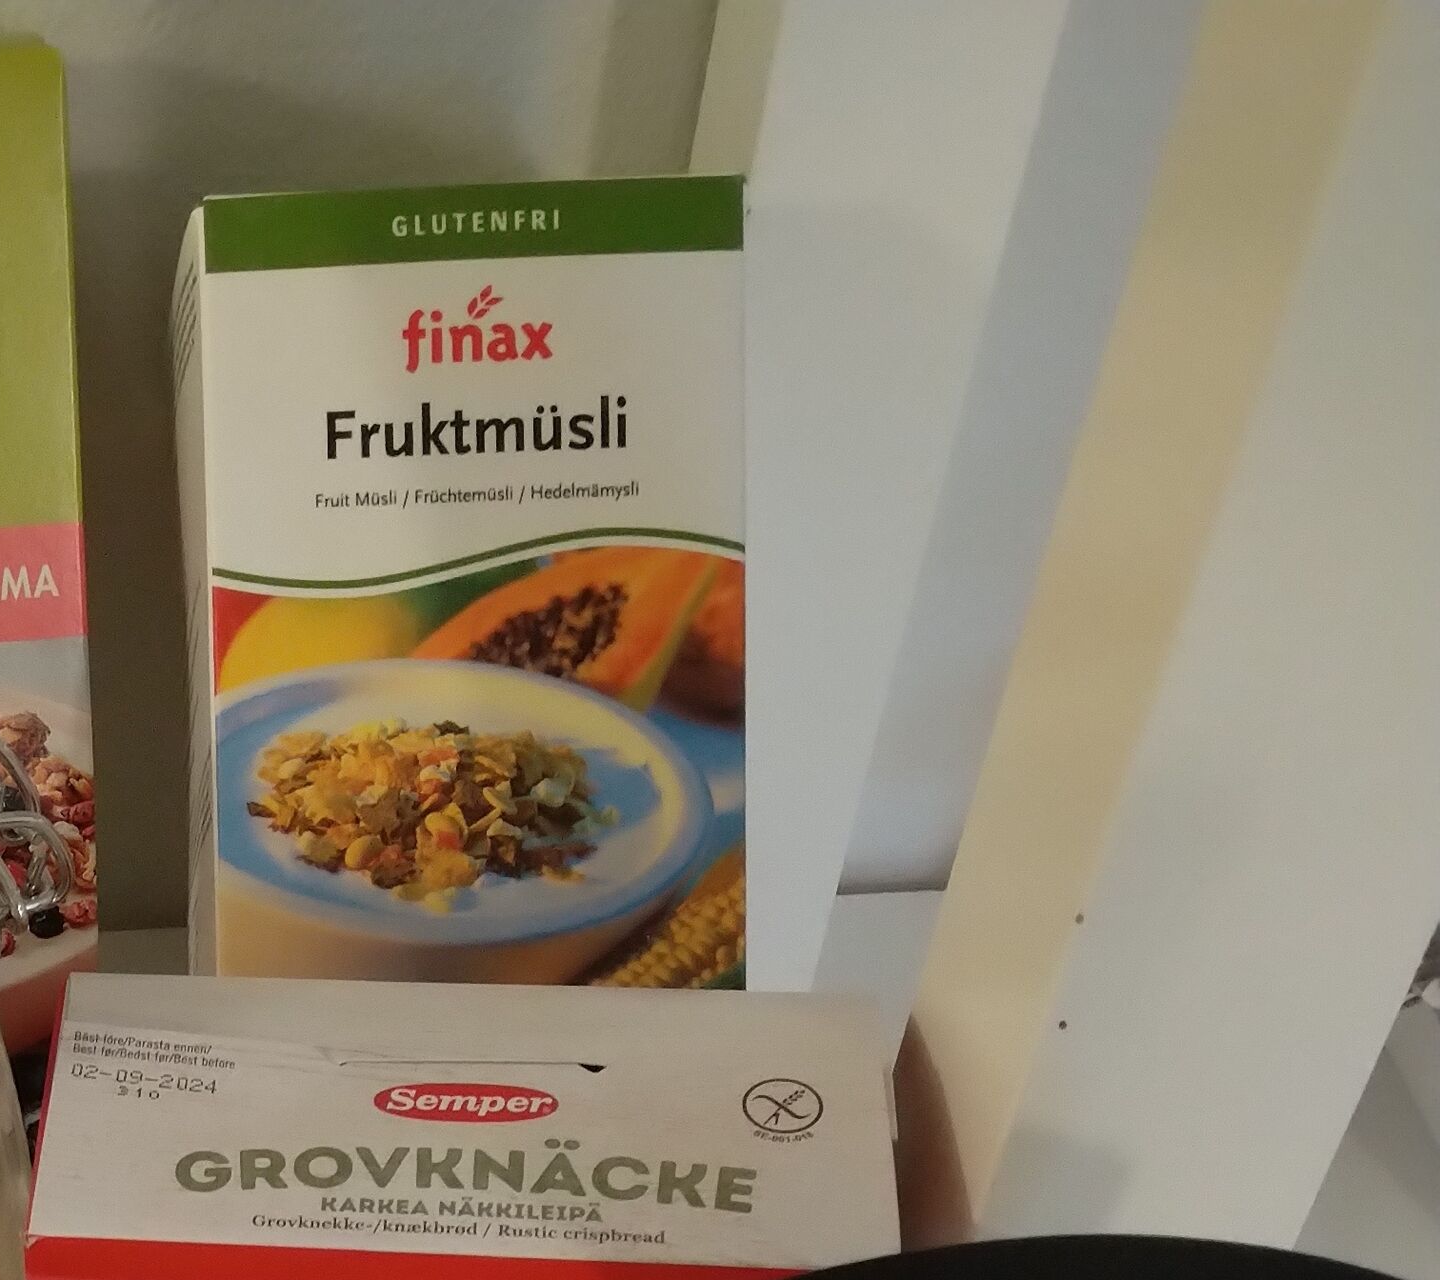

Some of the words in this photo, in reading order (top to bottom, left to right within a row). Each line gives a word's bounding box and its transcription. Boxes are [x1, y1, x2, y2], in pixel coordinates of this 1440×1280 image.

[392, 209, 561, 237] GLUTENFRI
[402, 308, 554, 374] finax
[325, 395, 627, 460] Fruktmüsli
[315, 493, 350, 508] Fruit
[355, 490, 397, 507] Müsli
[414, 486, 513, 506] Früchtemüsli
[530, 481, 640, 502] Hedelmämysli
[70, 1062, 217, 1095] 02-09-2024
[384, 1087, 552, 1119] Semper
[174, 1138, 758, 1213] GROVKNÄCKE
[321, 1197, 429, 1217] KARKEA
[438, 1196, 604, 1223] NÄKKILEIPÄ
[498, 1223, 558, 1240] Rustic
[563, 1228, 666, 1246] crispbread
